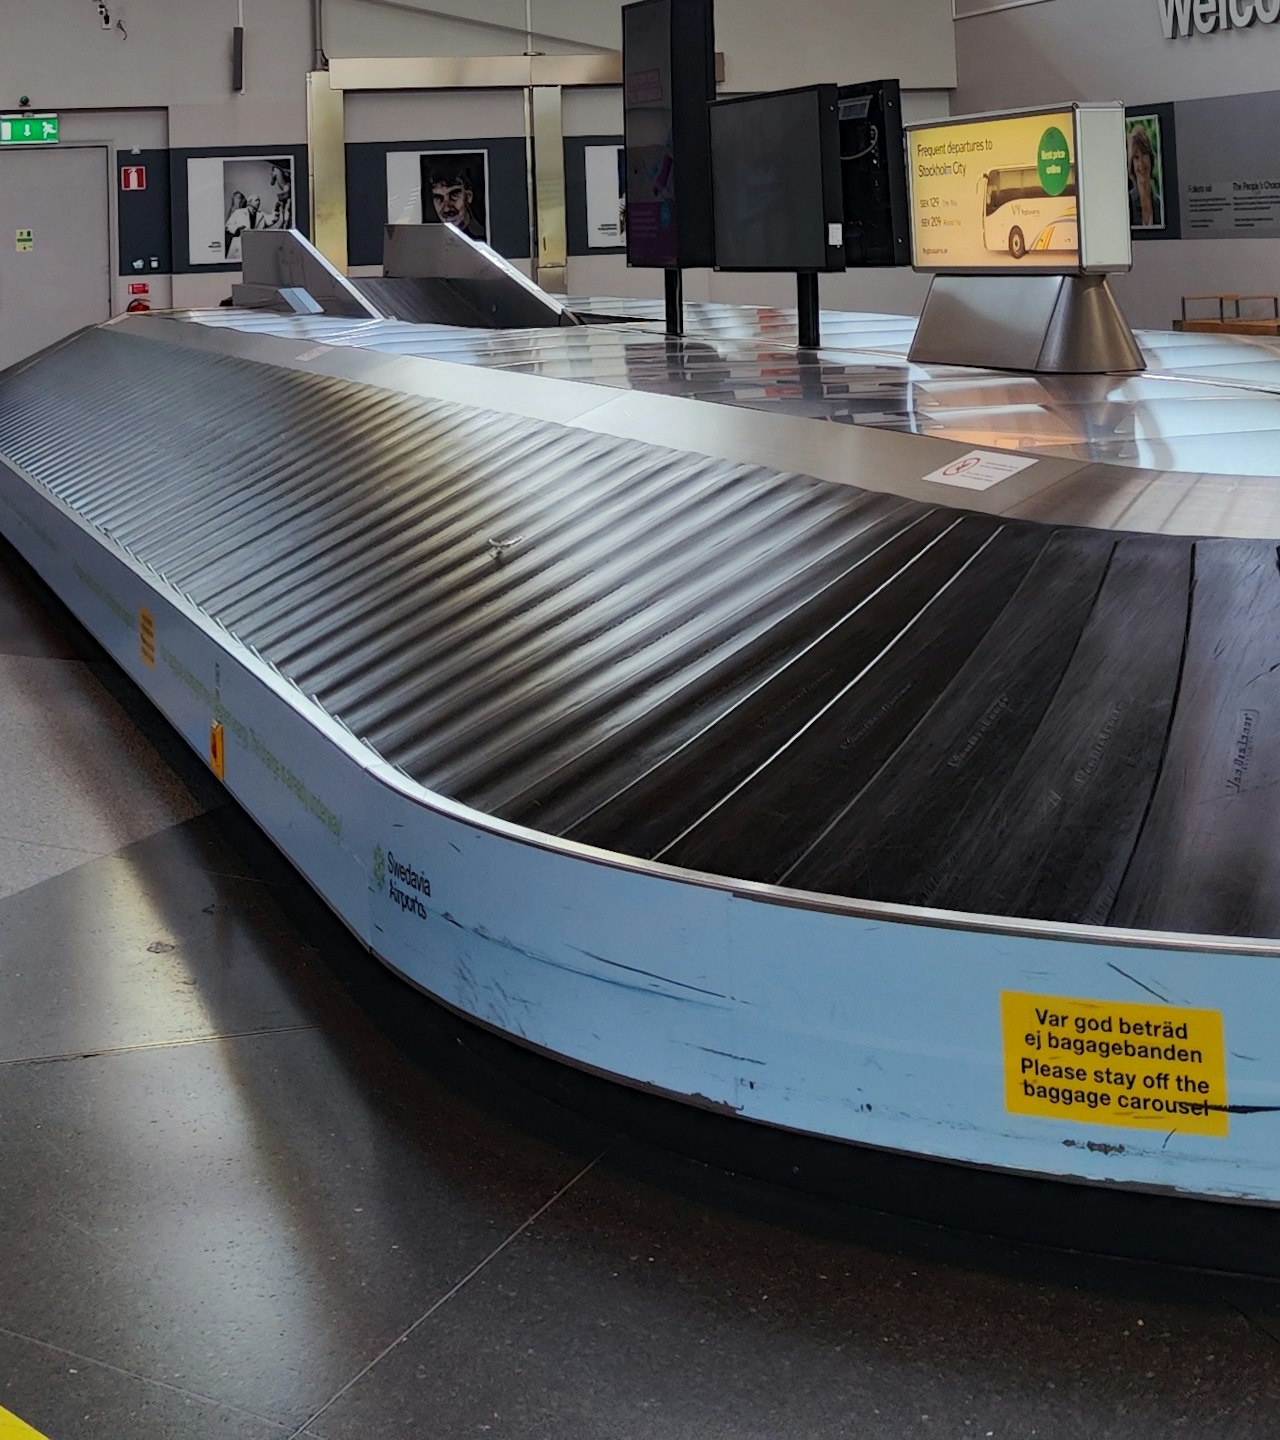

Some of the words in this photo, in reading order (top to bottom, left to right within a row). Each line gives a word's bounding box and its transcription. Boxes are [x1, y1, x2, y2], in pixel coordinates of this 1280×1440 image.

[917, 143, 947, 158] Frequent
[947, 139, 985, 156] departures
[985, 138, 993, 151] to
[918, 162, 953, 178] Stockholm
[953, 160, 966, 177] City
[920, 198, 929, 209] SEK
[930, 196, 940, 207] 129
[921, 218, 930, 227] SEK
[931, 216, 941, 227] 209
[388, 851, 431, 898] Swedavia
[390, 879, 427, 920] Airports
[1035, 1008, 1069, 1028] Var
[1075, 1016, 1113, 1034] god
[1119, 1017, 1188, 1040] beträd
[1024, 1030, 1042, 1050] ej
[1048, 1031, 1203, 1064] bagagebanden
[1021, 1057, 1088, 1081] Please
[1093, 1067, 1136, 1090] stay
[1143, 1072, 1170, 1090] off
[1176, 1074, 1210, 1094] the
[1023, 1080, 1111, 1108] baggage
[1118, 1094, 1209, 1117] carousel
